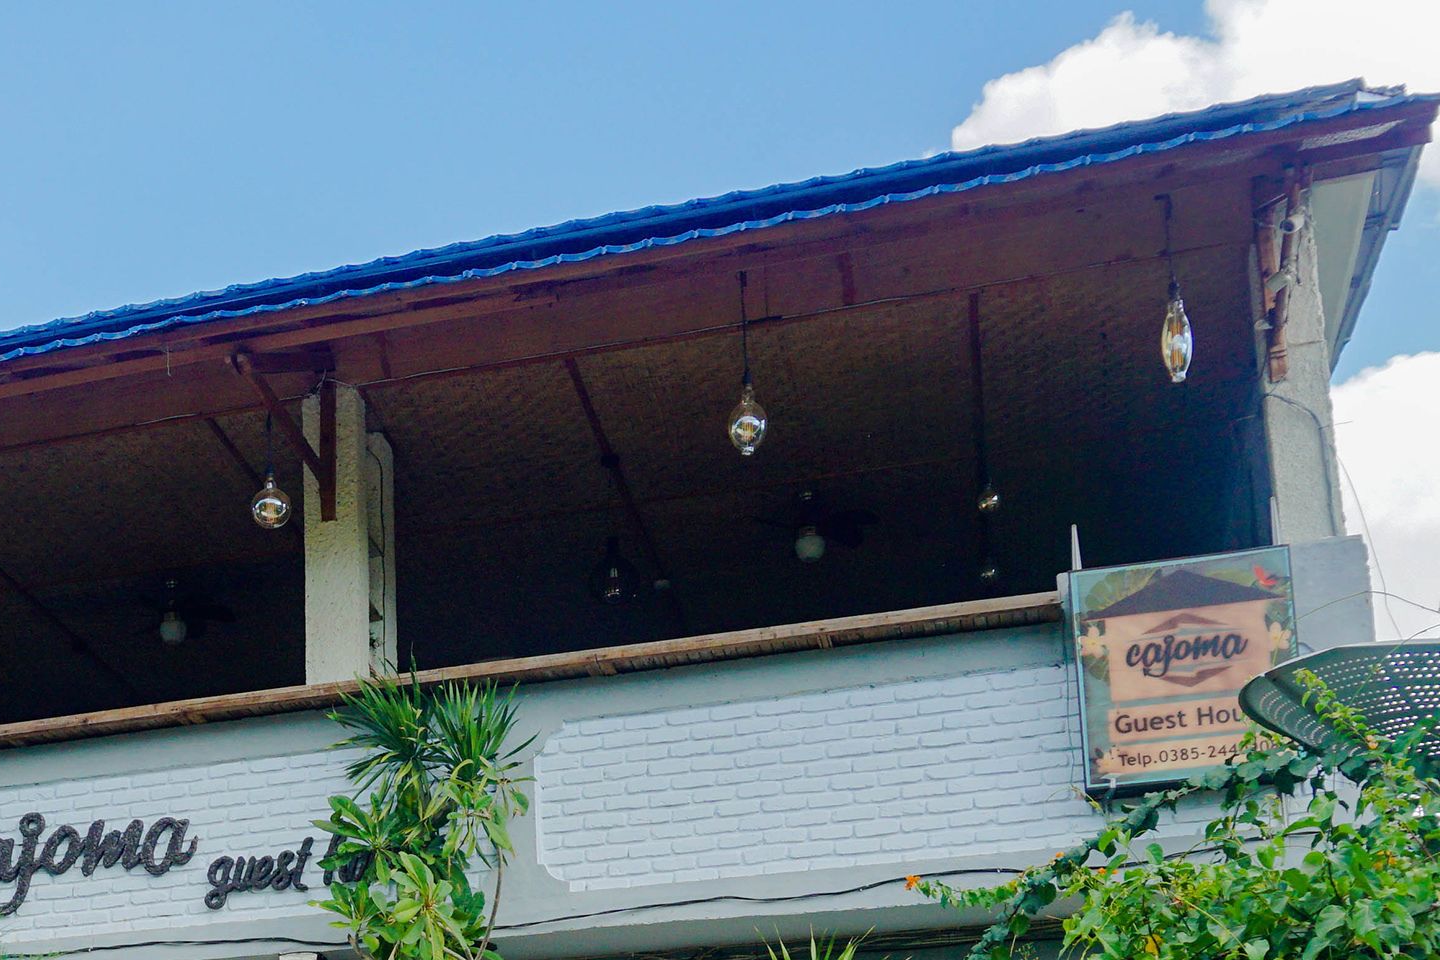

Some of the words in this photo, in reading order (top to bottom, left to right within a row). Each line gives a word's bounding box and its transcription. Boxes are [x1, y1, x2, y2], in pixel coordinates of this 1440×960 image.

[1125, 633, 1250, 678] cajoma
[1114, 710, 1188, 735] Guest
[1196, 705, 1242, 726] Hou
[204, 836, 313, 910] guest
